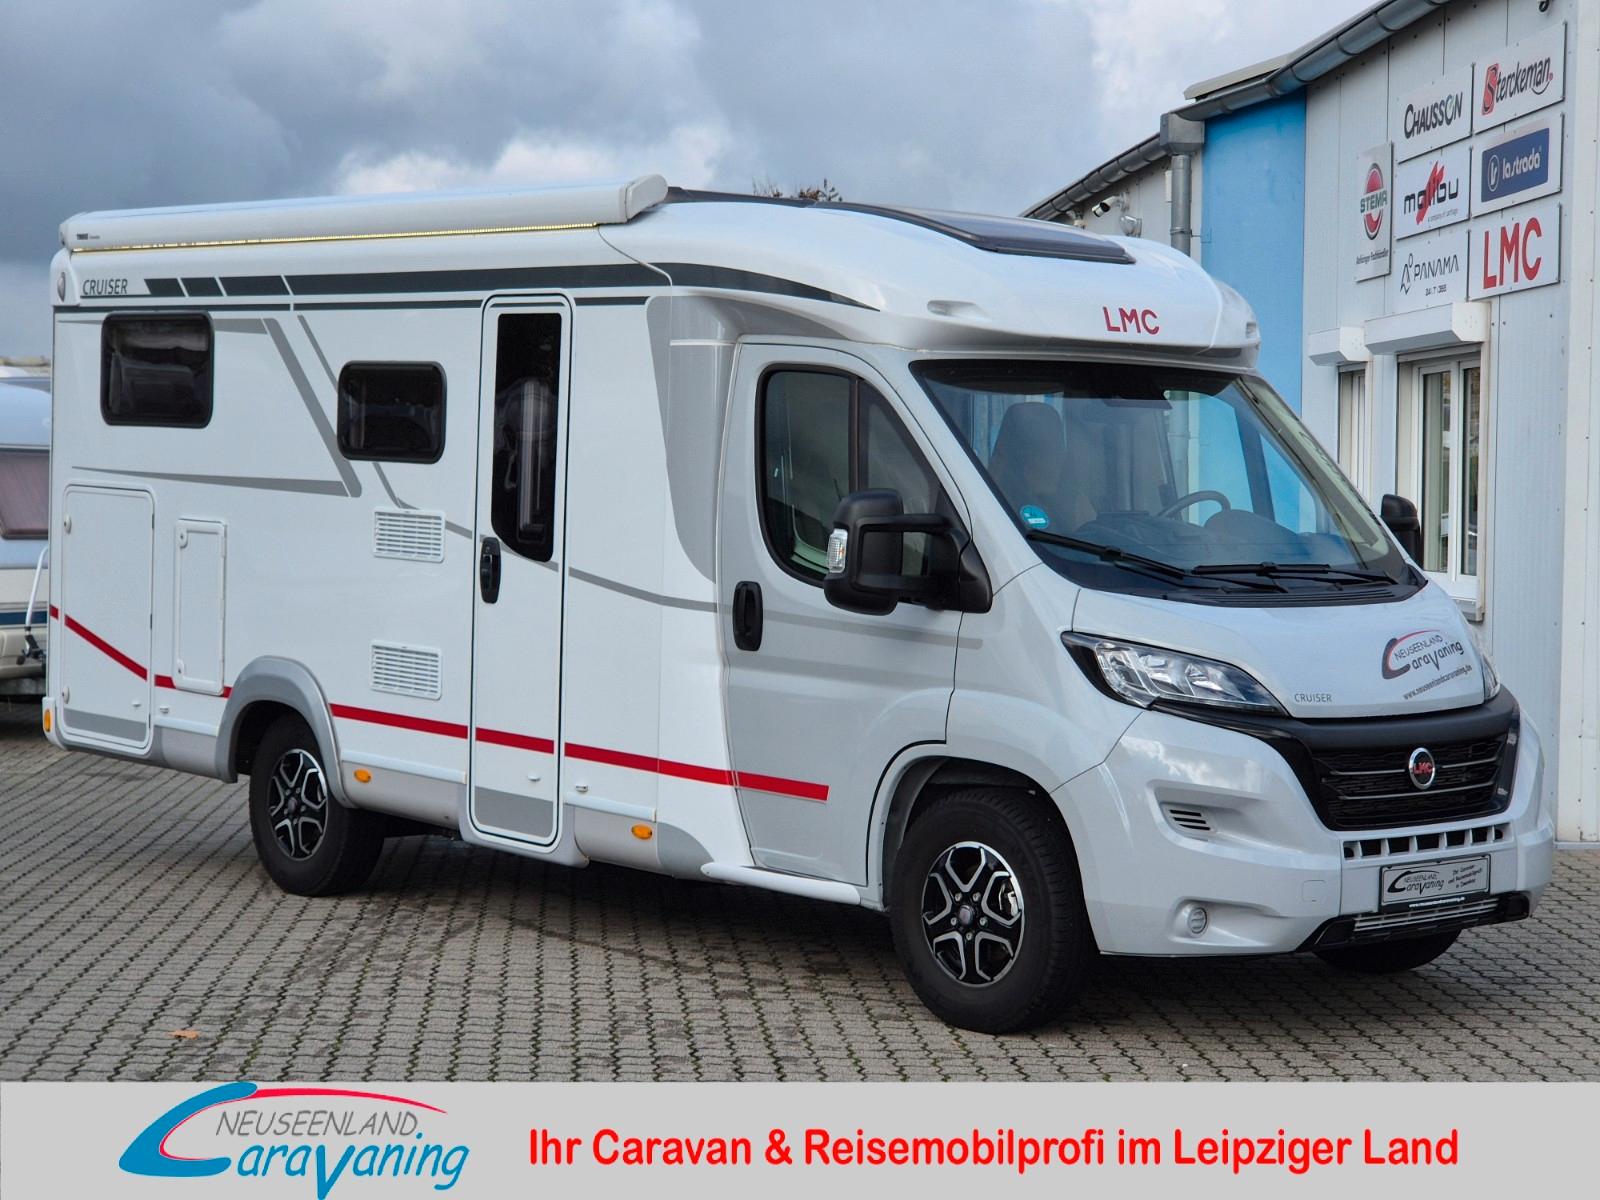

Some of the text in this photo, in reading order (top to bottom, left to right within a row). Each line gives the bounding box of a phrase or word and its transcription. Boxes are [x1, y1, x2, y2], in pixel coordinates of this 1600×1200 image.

[1482, 57, 1551, 115] Sterckeman
[1404, 91, 1463, 139] CHAUSSON
[1360, 189, 1388, 213] STEMA
[1404, 166, 1459, 220] malibu
[1414, 254, 1459, 281] PANAMA
[1483, 217, 1542, 289] LMC
[82, 278, 128, 296] CRUISER
[1102, 306, 1160, 335] LMC
[1382, 637, 1464, 680] Caravaning
[1394, 634, 1443, 660] NEUSEENLAND
[1294, 693, 1332, 703] CRUISER
